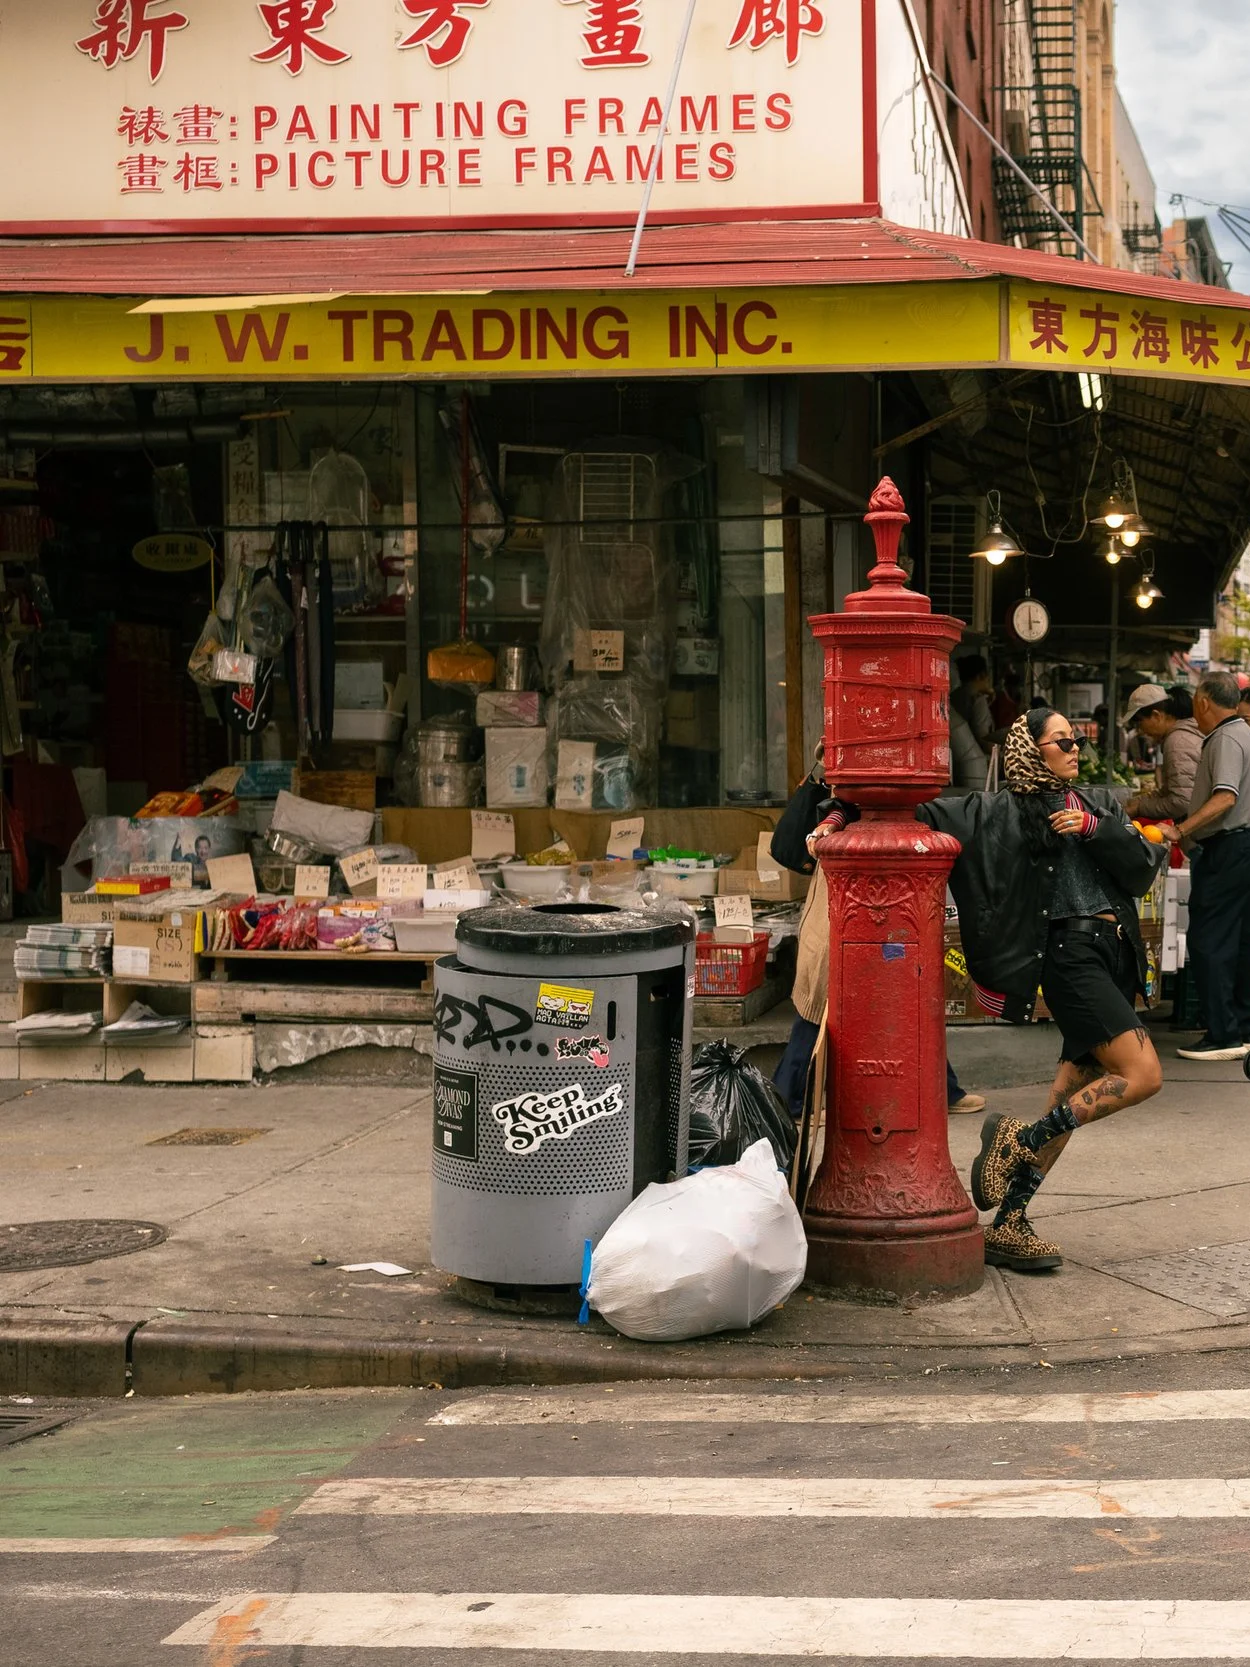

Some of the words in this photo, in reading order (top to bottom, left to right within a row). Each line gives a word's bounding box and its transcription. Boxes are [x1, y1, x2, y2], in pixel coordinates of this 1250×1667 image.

[253, 99, 529, 143] PAINTING
[564, 92, 794, 137] FRAMES
[254, 147, 482, 191] PICTURE
[514, 142, 736, 186] FRAMES
[123, 312, 190, 363] J.
[214, 312, 309, 362] W.
[327, 305, 630, 362] TRADING
[668, 300, 793, 358] INC.
[157, 927, 182, 938] SIZE
[434, 1080, 471, 1106] DIAMOND
[437, 1097, 463, 1120] DIVAS
[495, 1088, 581, 1125] Keep
[509, 1091, 620, 1150] Smiling
